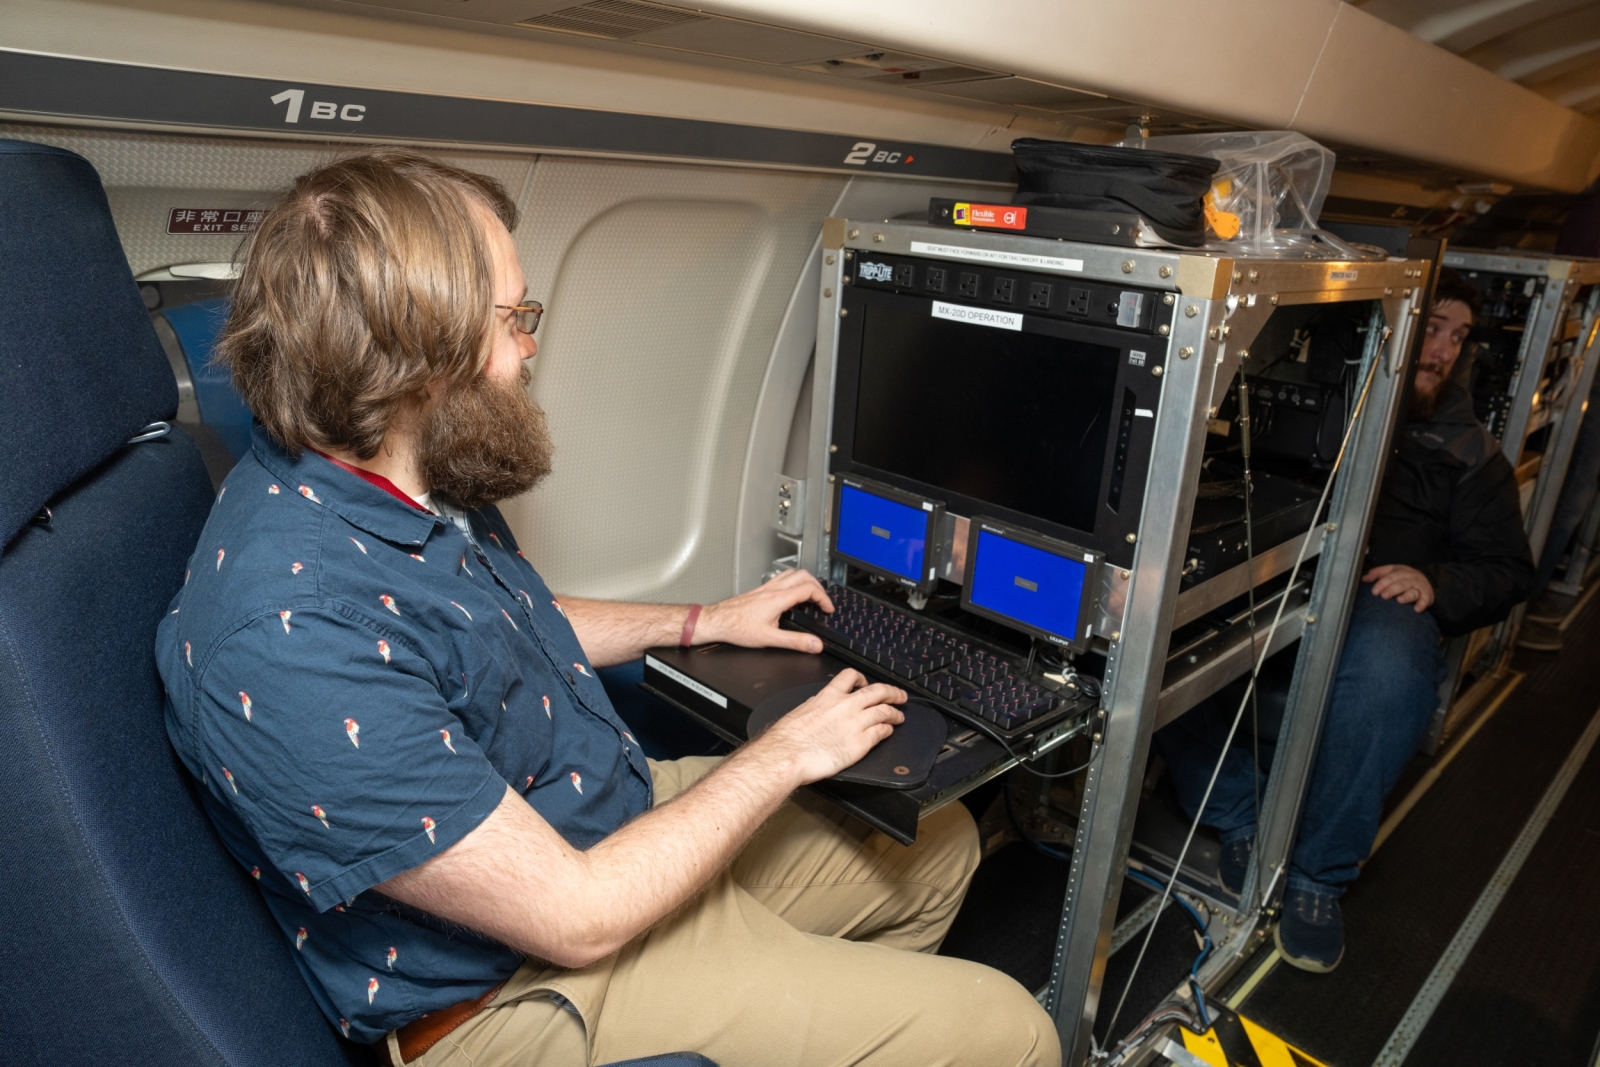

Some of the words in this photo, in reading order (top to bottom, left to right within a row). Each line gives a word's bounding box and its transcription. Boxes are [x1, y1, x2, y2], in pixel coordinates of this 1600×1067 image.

[270, 88, 305, 123] 1
[310, 101, 366, 122] BC
[843, 141, 876, 165] 2
[872, 150, 902, 164] BC
[971, 209, 995, 218] Flexible
[193, 224, 223, 232] EXIT
[960, 249, 982, 257] FORWARD
[938, 306, 966, 318] MX-20D
[967, 311, 1015, 326] OPERATION
[1049, 634, 1070, 647] LILLIPUT
